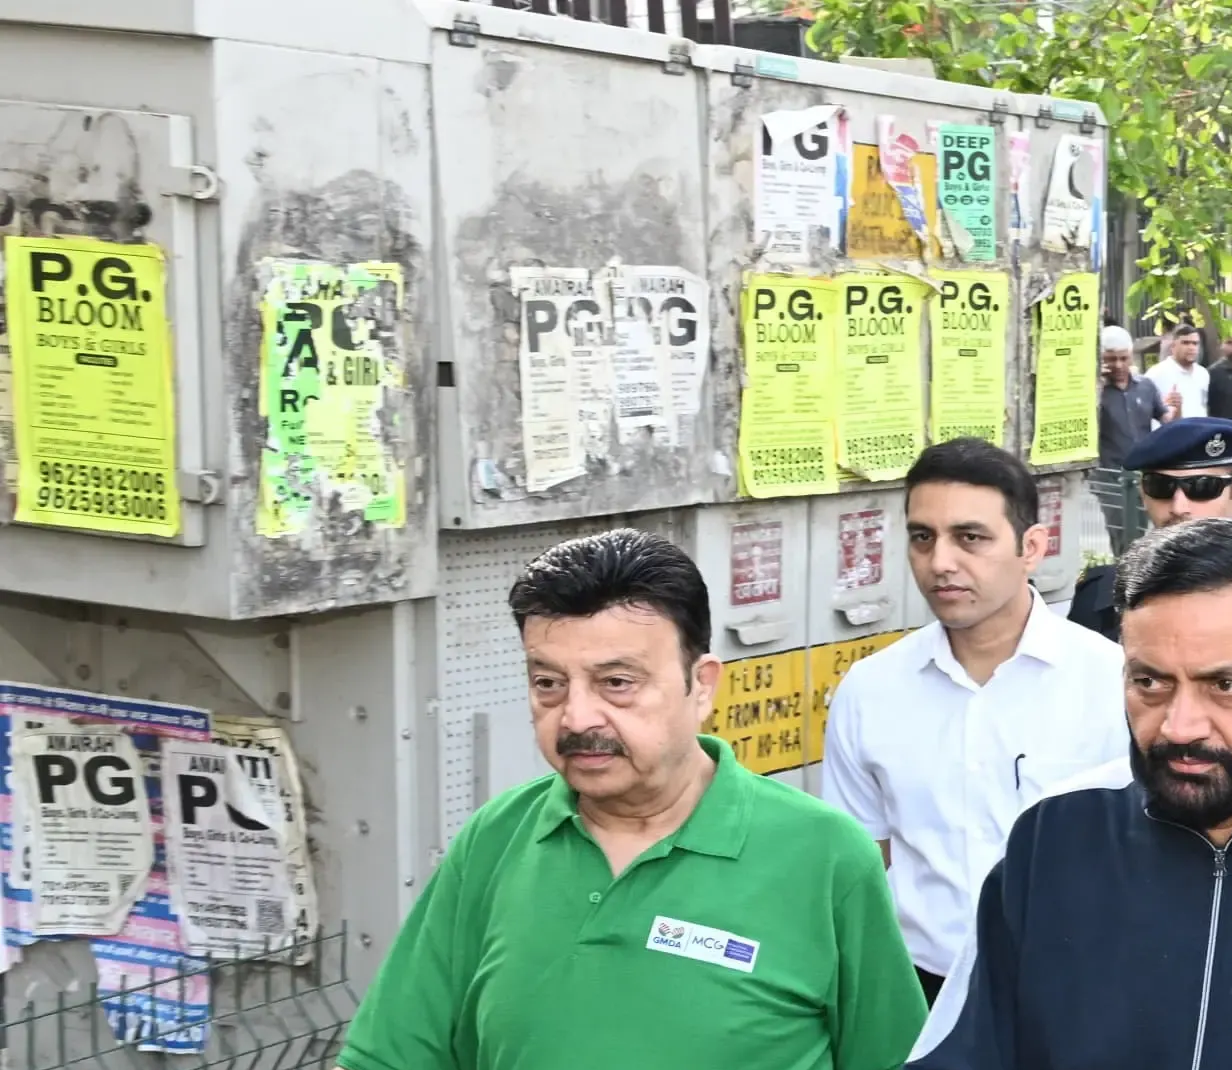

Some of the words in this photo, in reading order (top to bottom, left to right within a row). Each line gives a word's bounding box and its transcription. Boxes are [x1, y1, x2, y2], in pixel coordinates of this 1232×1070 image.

[943, 135, 990, 149] DEEP
[30, 251, 152, 302] P.G.
[753, 288, 823, 321] P.G.
[846, 285, 913, 315] P.G.
[940, 281, 999, 312] P.G.
[36, 296, 145, 331] BLOOM
[848, 317, 905, 337] BLOOM
[942, 312, 992, 331] BLOOM
[36, 333, 81, 350] BOYS
[84, 337, 97, 351] &
[100, 339, 147, 355] GIRLS
[756, 323, 816, 343] BLOOM
[727, 699, 761, 729] FROM
[32, 754, 136, 806] PG
[652, 936, 682, 949] GMDA
[692, 935, 724, 950] MCG
